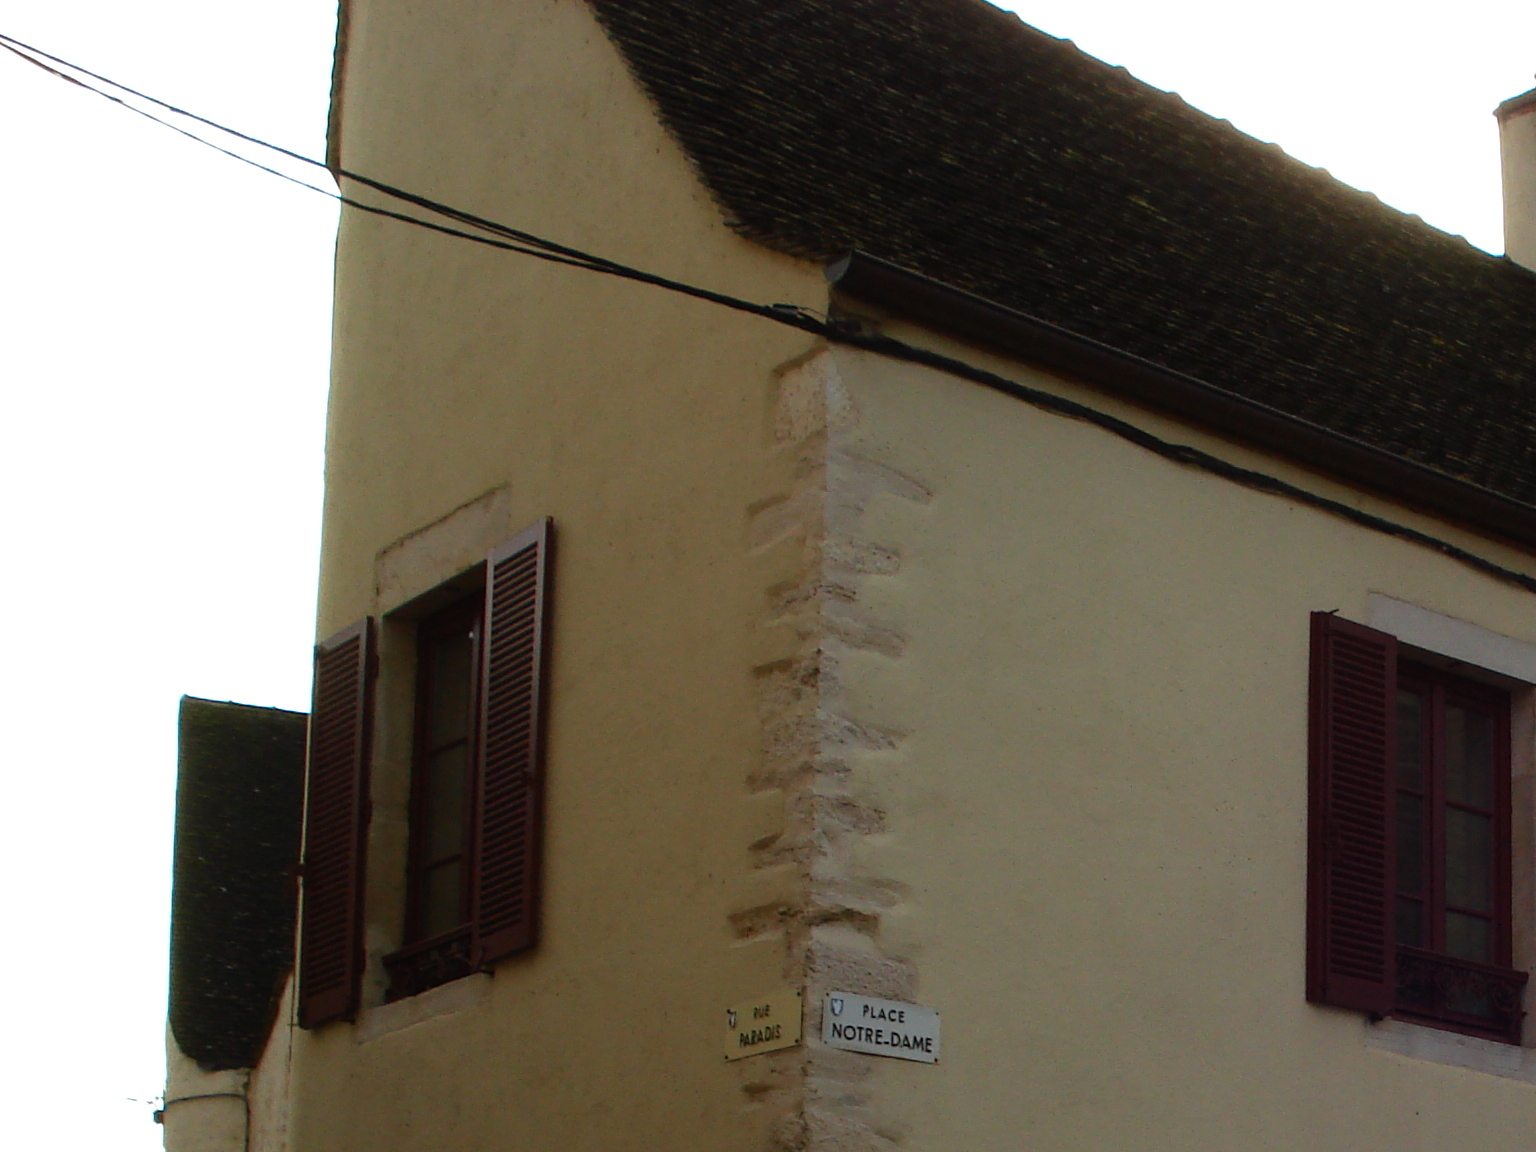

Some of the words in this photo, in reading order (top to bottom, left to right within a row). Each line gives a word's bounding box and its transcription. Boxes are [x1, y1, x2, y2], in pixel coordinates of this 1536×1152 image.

[752, 1004, 770, 1019] RUE
[863, 1005, 905, 1024] PLACE
[740, 1024, 781, 1047] PARADIS
[832, 1023, 932, 1053] NOTRE-DAME
